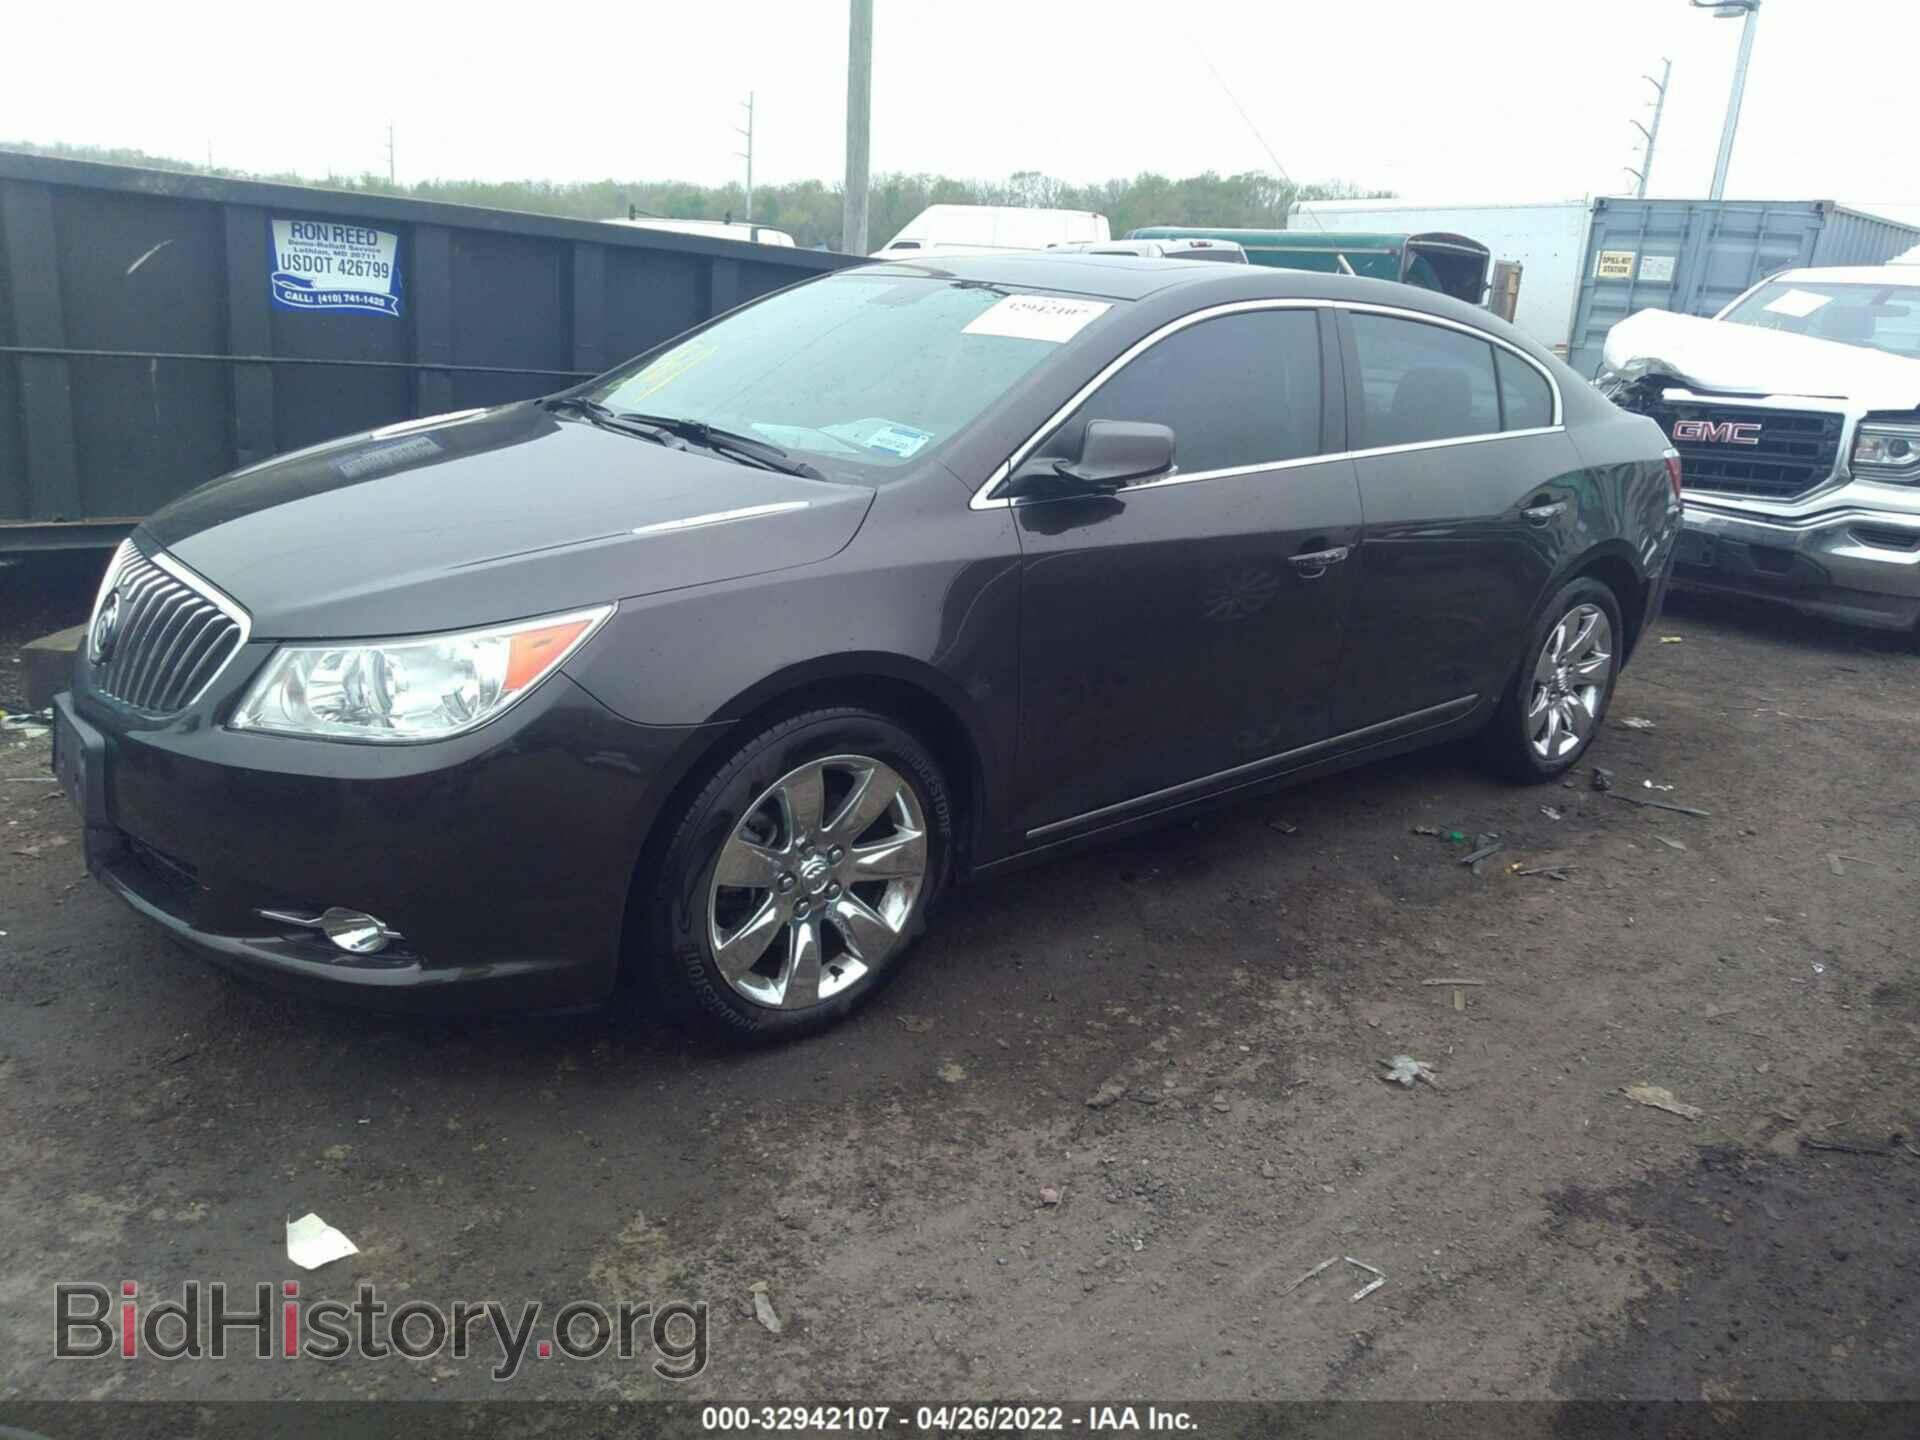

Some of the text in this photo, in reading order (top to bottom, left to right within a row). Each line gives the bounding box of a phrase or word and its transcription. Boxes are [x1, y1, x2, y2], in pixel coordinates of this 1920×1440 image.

[291, 222, 378, 246] RON REED
[281, 253, 390, 279] USDOT 426799
[284, 290, 313, 303] CALL:
[318, 294, 343, 305] (410)
[1672, 420, 1762, 445] GMC
